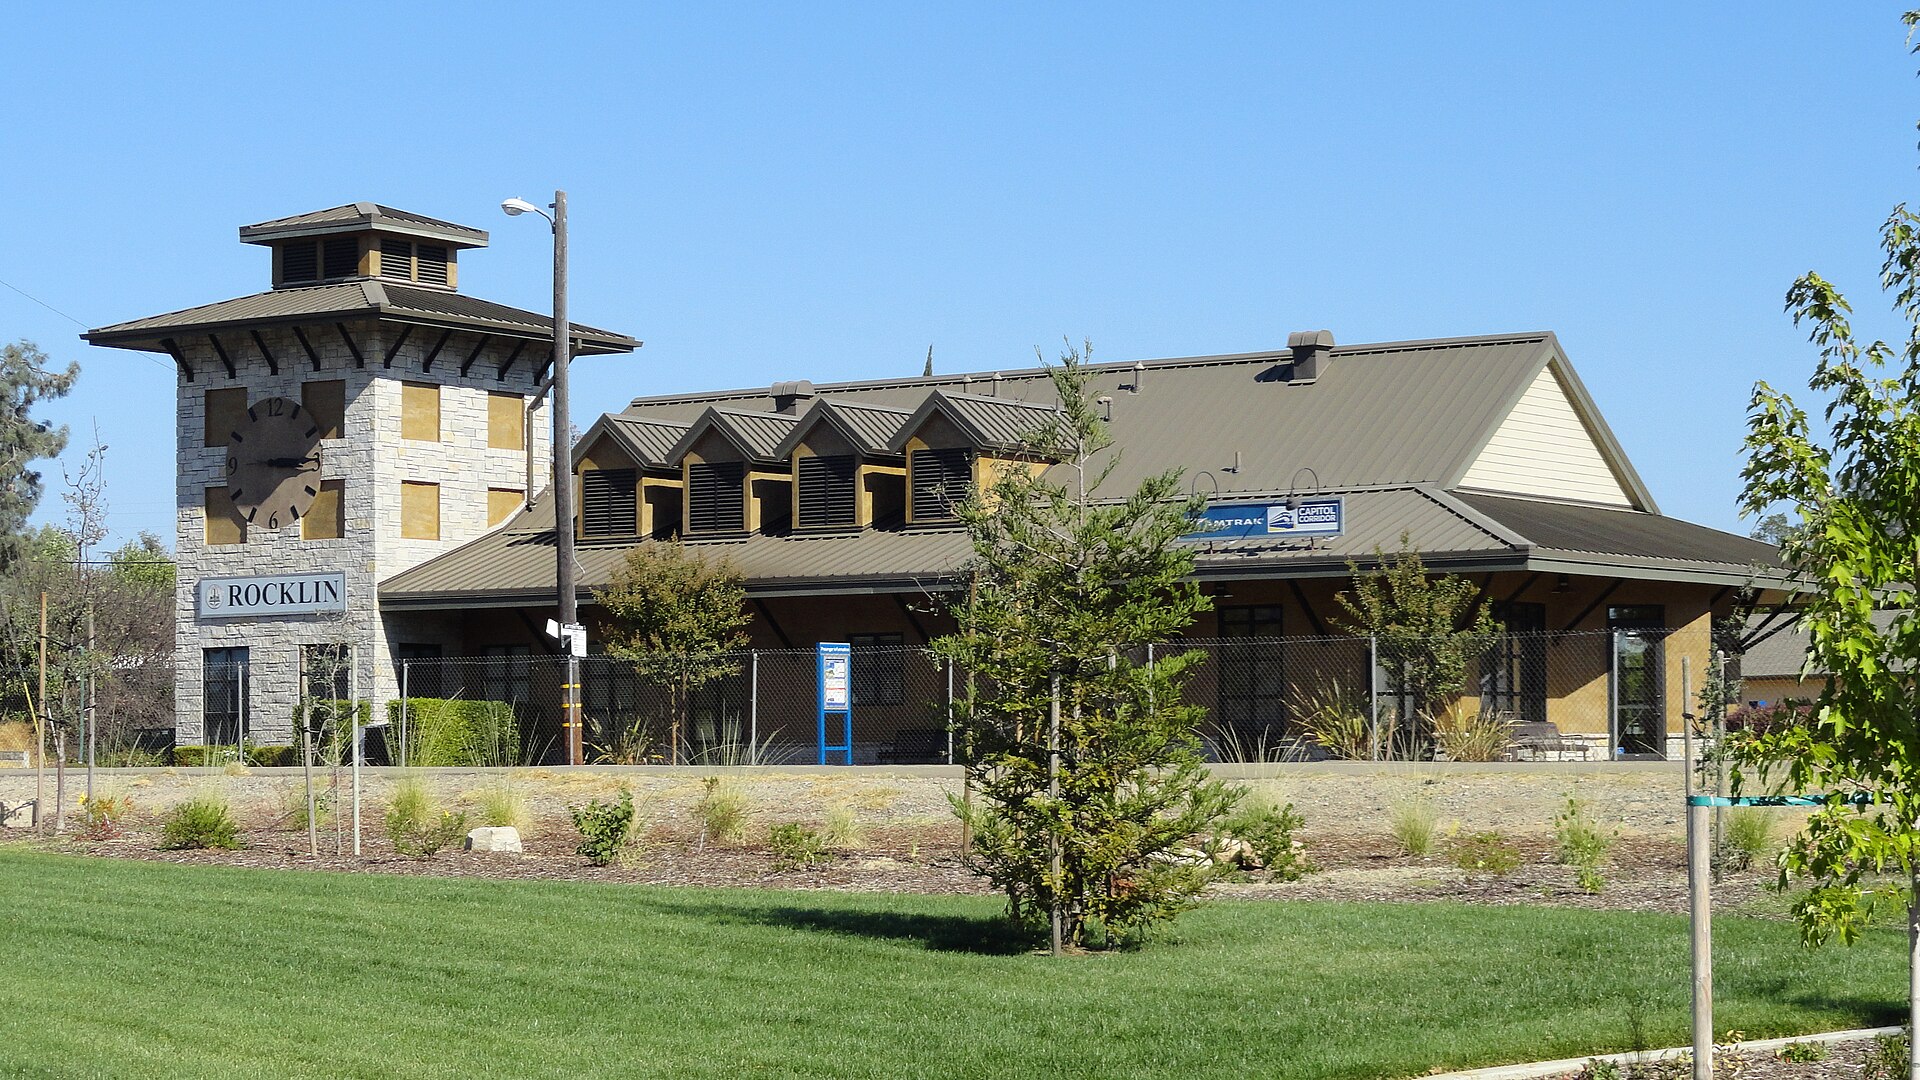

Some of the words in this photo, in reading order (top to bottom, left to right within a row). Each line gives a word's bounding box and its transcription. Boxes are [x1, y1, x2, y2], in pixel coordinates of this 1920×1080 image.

[267, 398, 283, 417] 12
[228, 457, 238, 476] 9
[269, 510, 278, 529] 6
[1298, 506, 1336, 515] CAPITOL
[1298, 514, 1336, 523] CORRIDOR
[228, 580, 340, 607] ROCKLIN
